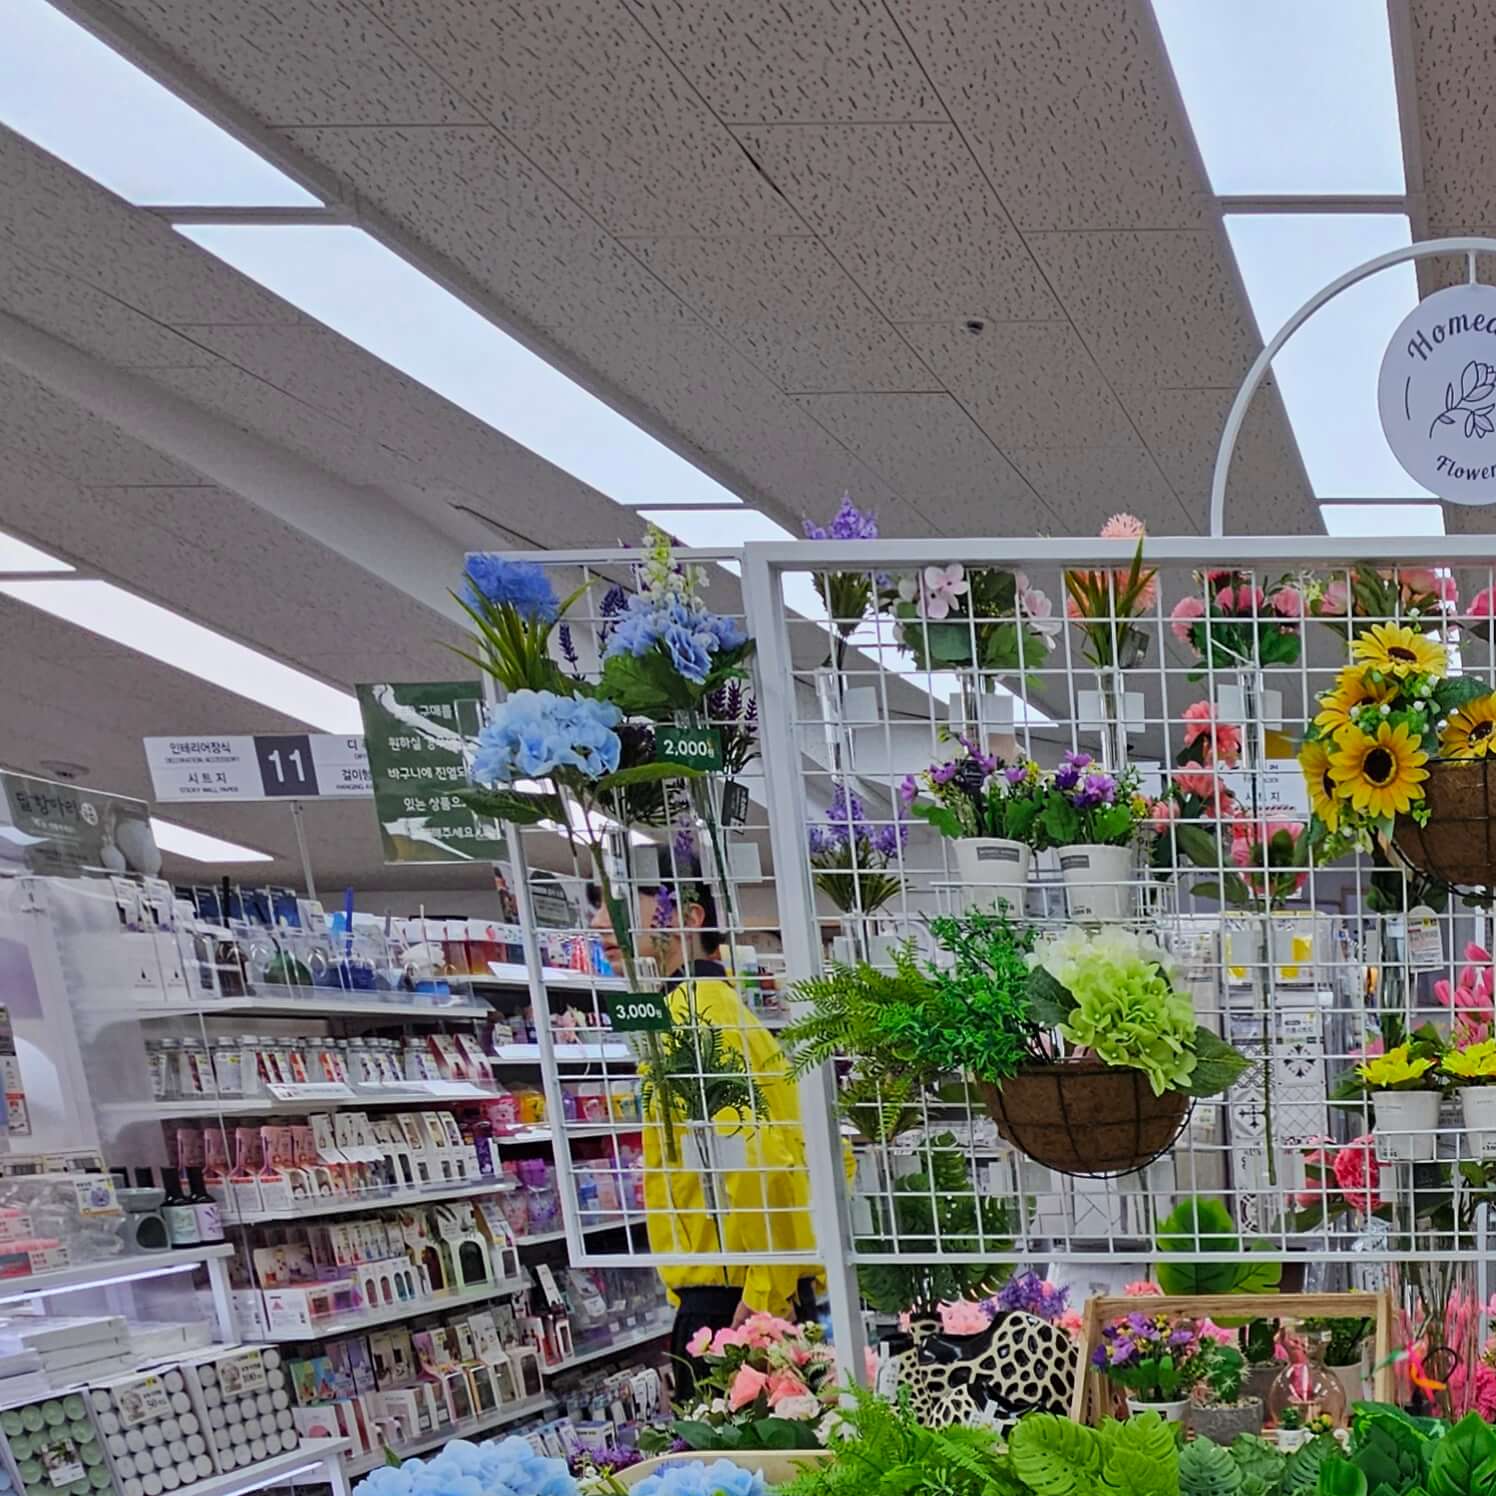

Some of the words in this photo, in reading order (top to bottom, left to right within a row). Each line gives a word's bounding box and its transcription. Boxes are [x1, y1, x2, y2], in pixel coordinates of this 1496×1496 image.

[169, 741, 232, 754] 인테리어장식
[268, 749, 305, 782] 11
[387, 766, 433, 780] 바구니에
[435, 766, 469, 781] 진열되
[403, 797, 427, 812] 있는
[428, 796, 466, 812] 상품으
